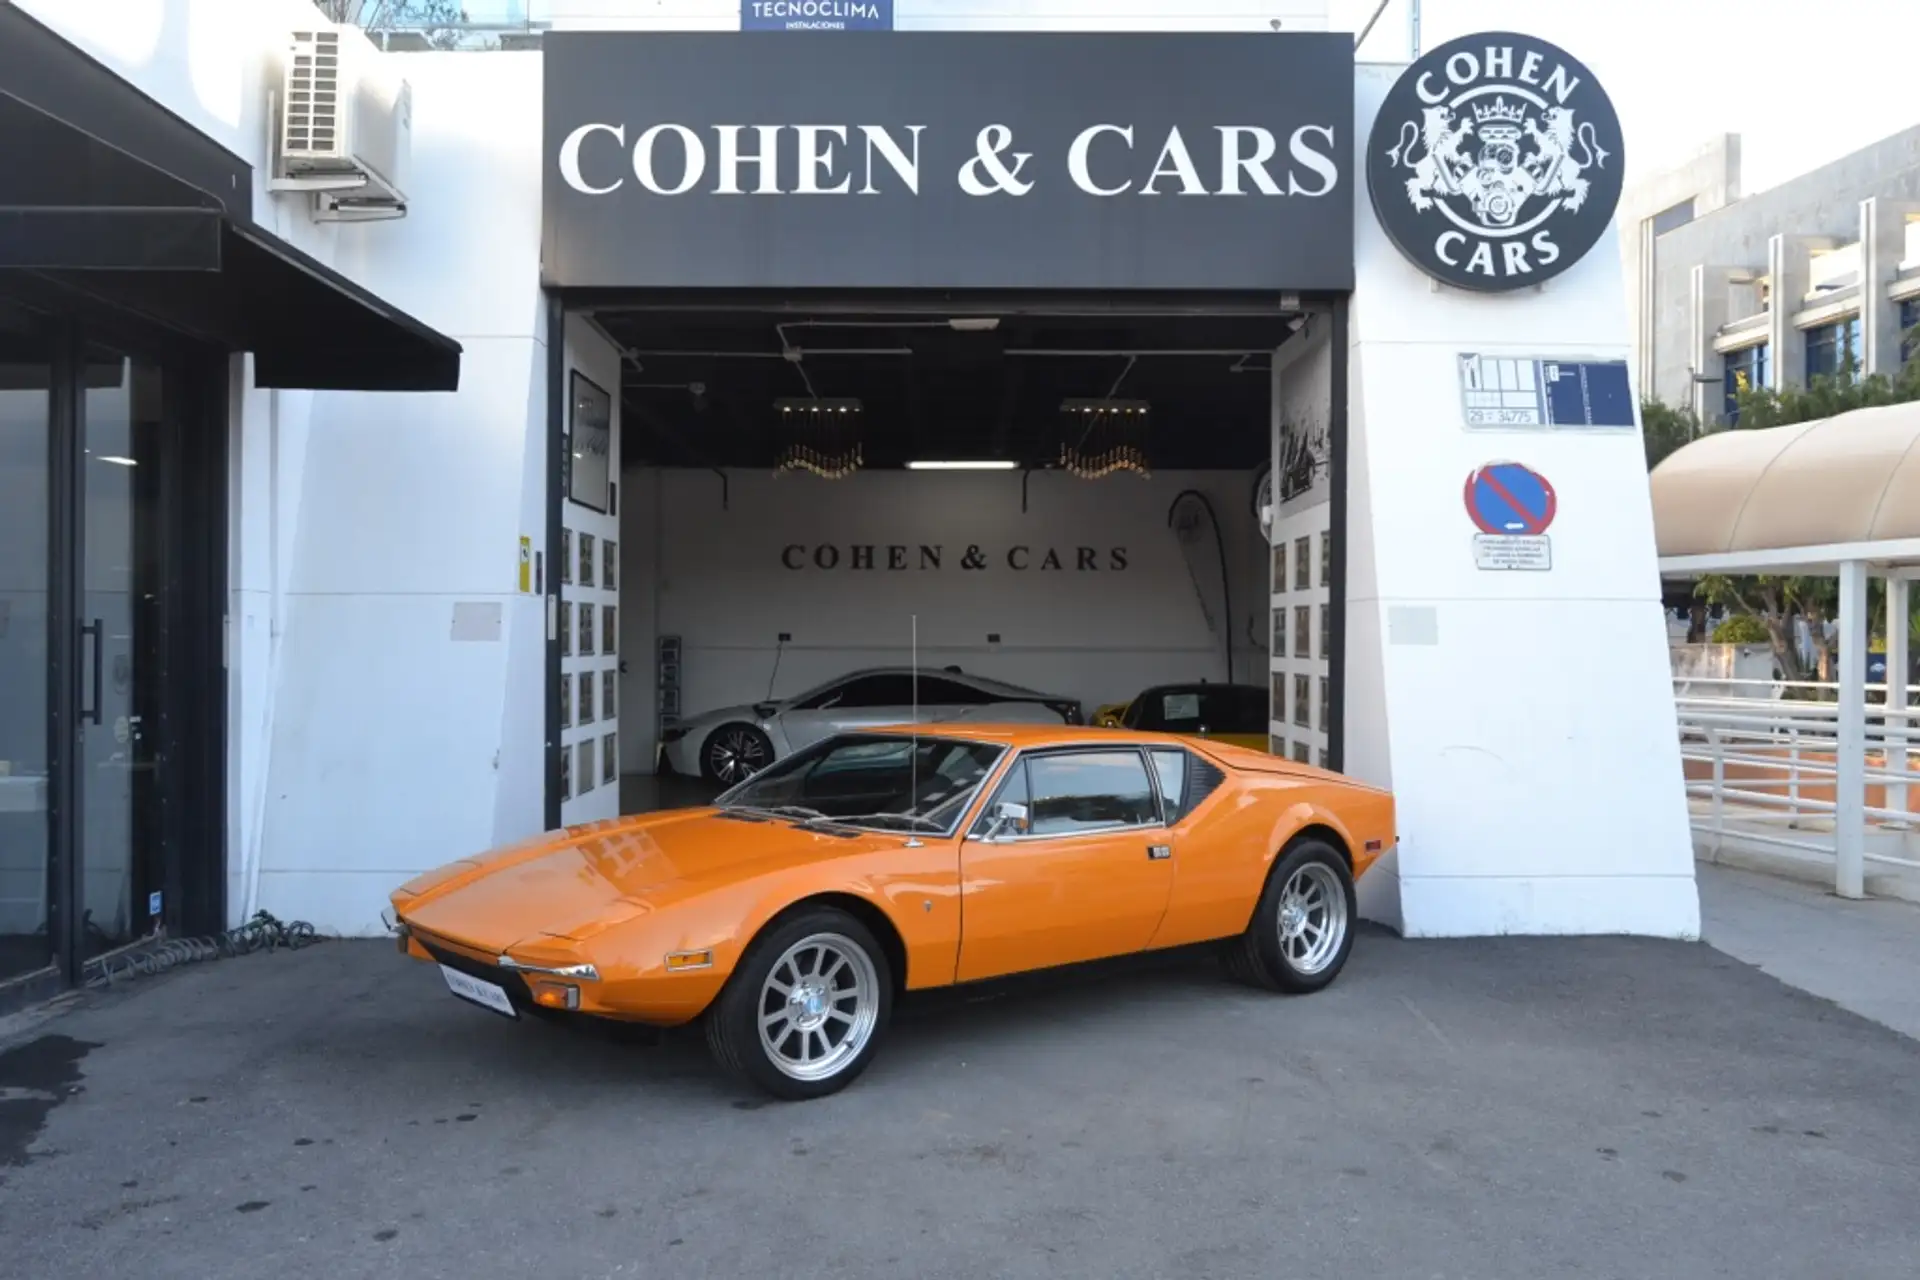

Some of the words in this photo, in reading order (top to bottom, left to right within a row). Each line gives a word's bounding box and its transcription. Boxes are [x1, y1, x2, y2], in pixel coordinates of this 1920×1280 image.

[752, 1, 879, 20] TECNOCLIMA
[1415, 46, 1580, 105] COHEN
[558, 123, 928, 196] COHEN
[957, 123, 1036, 196] &
[1067, 123, 1338, 197] CARS
[1434, 230, 1560, 277] CARS
[781, 543, 943, 571] COHEN
[960, 544, 987, 571] &
[1006, 545, 1129, 571] CARS
